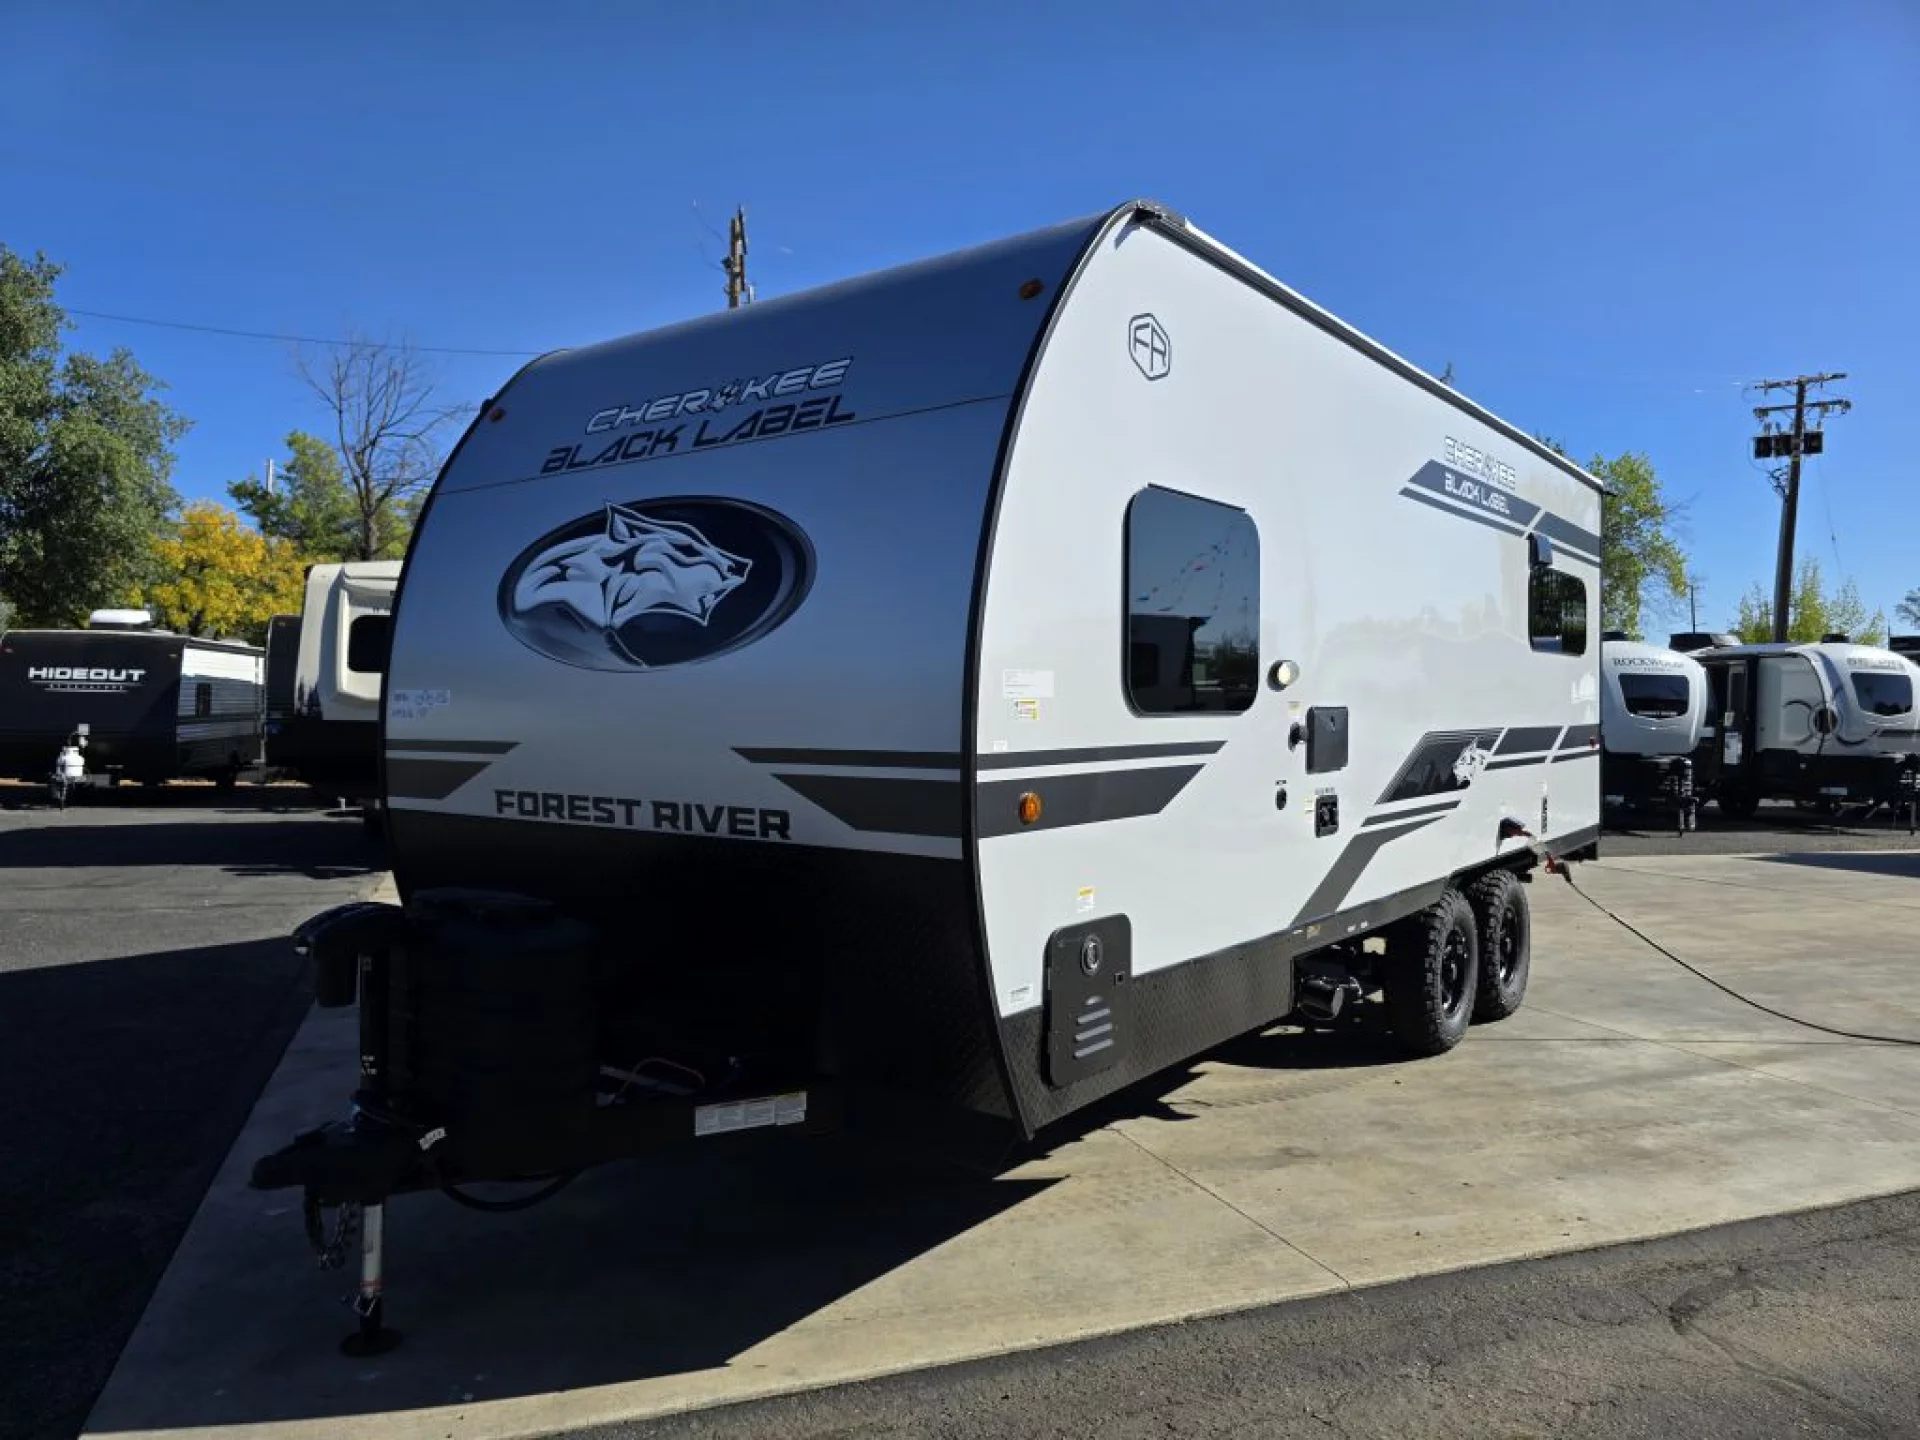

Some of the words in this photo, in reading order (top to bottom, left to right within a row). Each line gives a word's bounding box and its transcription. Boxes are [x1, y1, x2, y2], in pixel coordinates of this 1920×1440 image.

[585, 357, 854, 434] CHEROKEE
[540, 422, 686, 474] BLACK
[693, 395, 855, 448] LABEL
[28, 667, 146, 681] HIDEOUT
[494, 789, 642, 826] FOREST
[652, 801, 792, 841] RIVER
